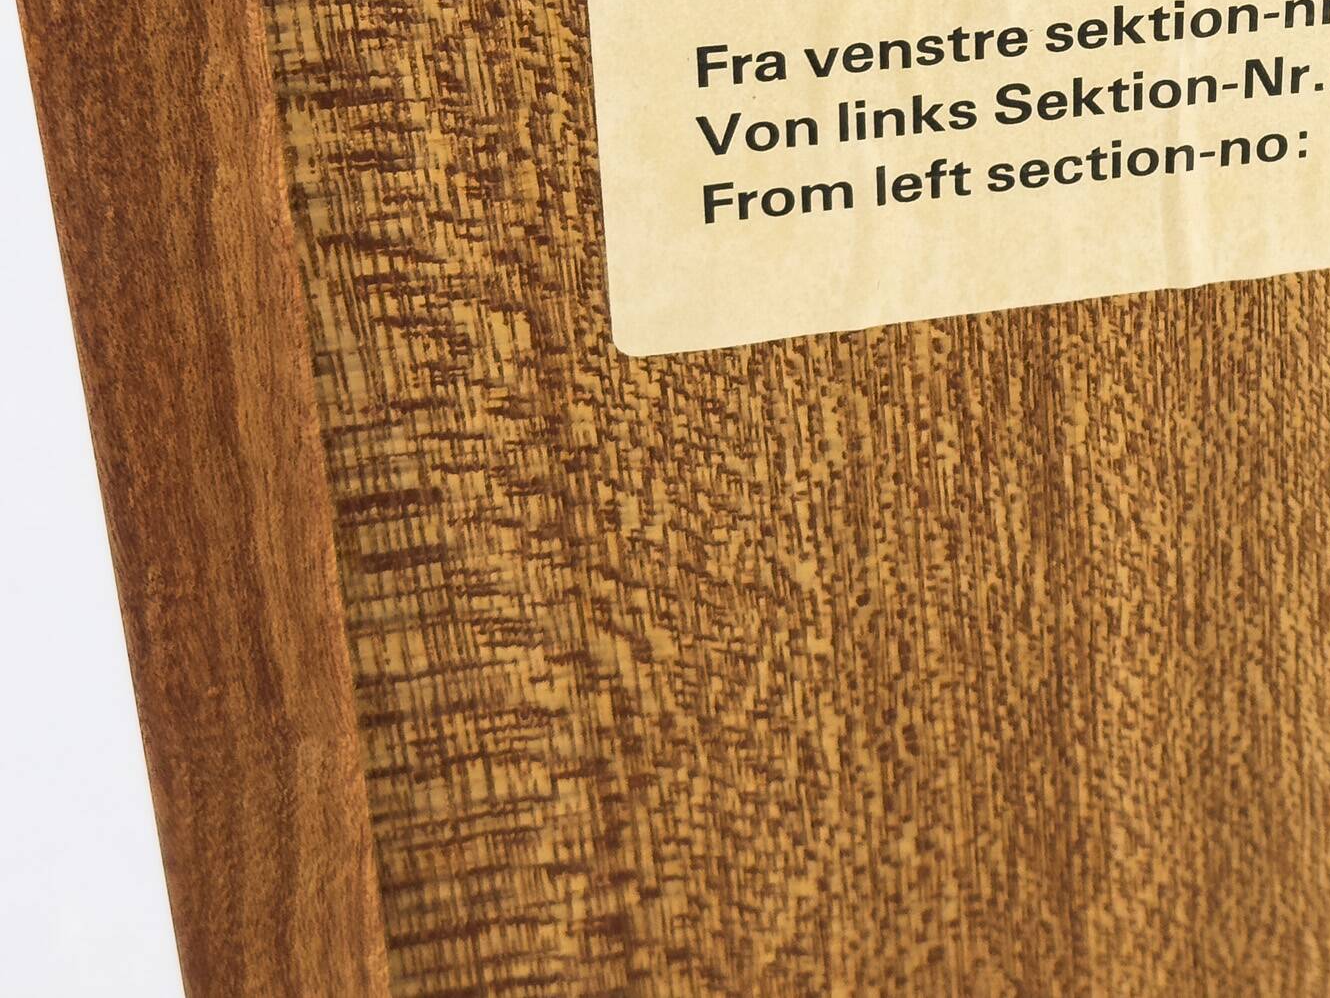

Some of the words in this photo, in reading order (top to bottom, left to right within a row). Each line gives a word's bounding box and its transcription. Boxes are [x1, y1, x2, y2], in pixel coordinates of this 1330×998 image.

[696, 44, 787, 88] Fra
[803, 26, 1028, 78] venstre
[695, 112, 819, 156] Von
[838, 94, 978, 143] links
[703, 181, 854, 225] From
[875, 158, 972, 207] left
[987, 130, 1308, 193] section-no:
